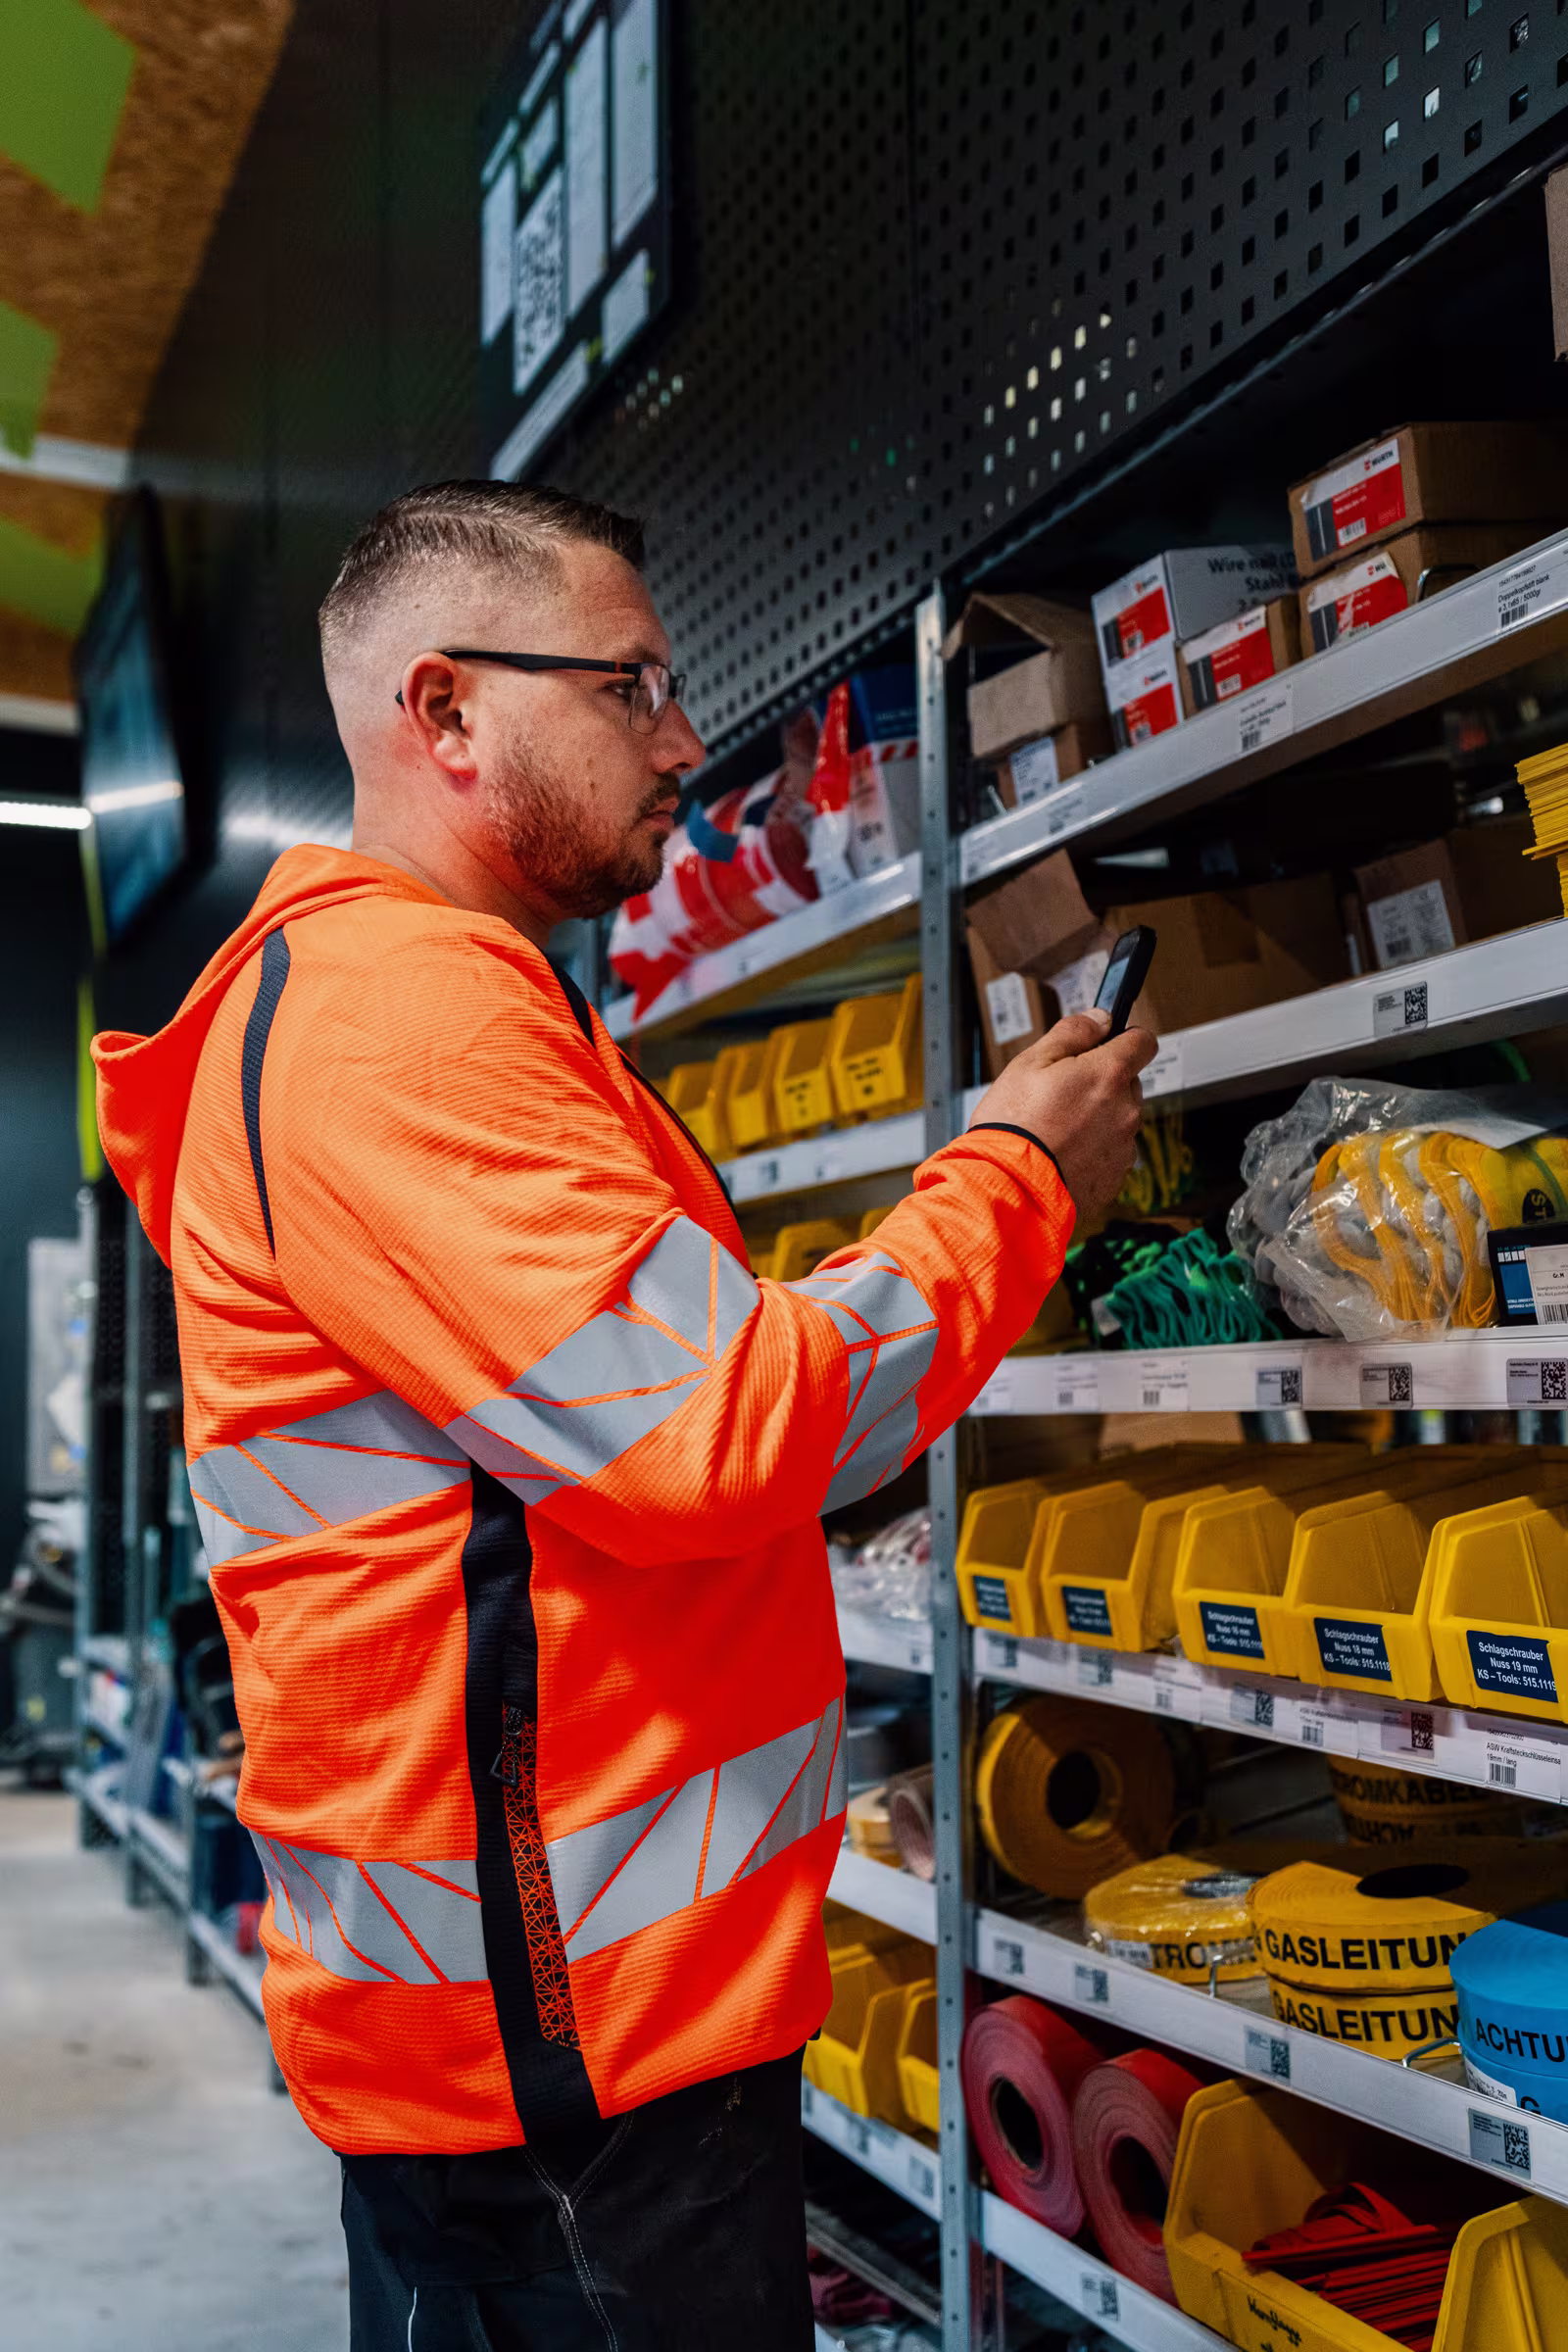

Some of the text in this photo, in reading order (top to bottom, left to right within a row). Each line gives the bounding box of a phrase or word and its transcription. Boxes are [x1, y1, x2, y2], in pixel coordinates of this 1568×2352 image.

[1324, 1628, 1379, 1643] Schlagschrauber
[1334, 1642, 1375, 1656] Nuss 18 mm
[1478, 1642, 1544, 1661] Schlagschrauber
[1323, 1652, 1334, 1663] KS
[1340, 1654, 1361, 1666] Tools:
[1490, 1656, 1538, 1674] Nuss 19 mm
[1477, 1668, 1490, 1680] KS
[1496, 1672, 1522, 1686] Tools:
[1523, 1676, 1556, 1691] 515.1119
[1487, 1742, 1499, 1752] ASW
[1487, 1753, 1502, 1763] 19mm
[1506, 1757, 1517, 1768] lang
[1264, 1928, 1467, 1970] GASLEITUN
[1273, 1989, 1459, 2042] GASLEITUN
[1475, 2017, 1568, 2063] ACHTU
